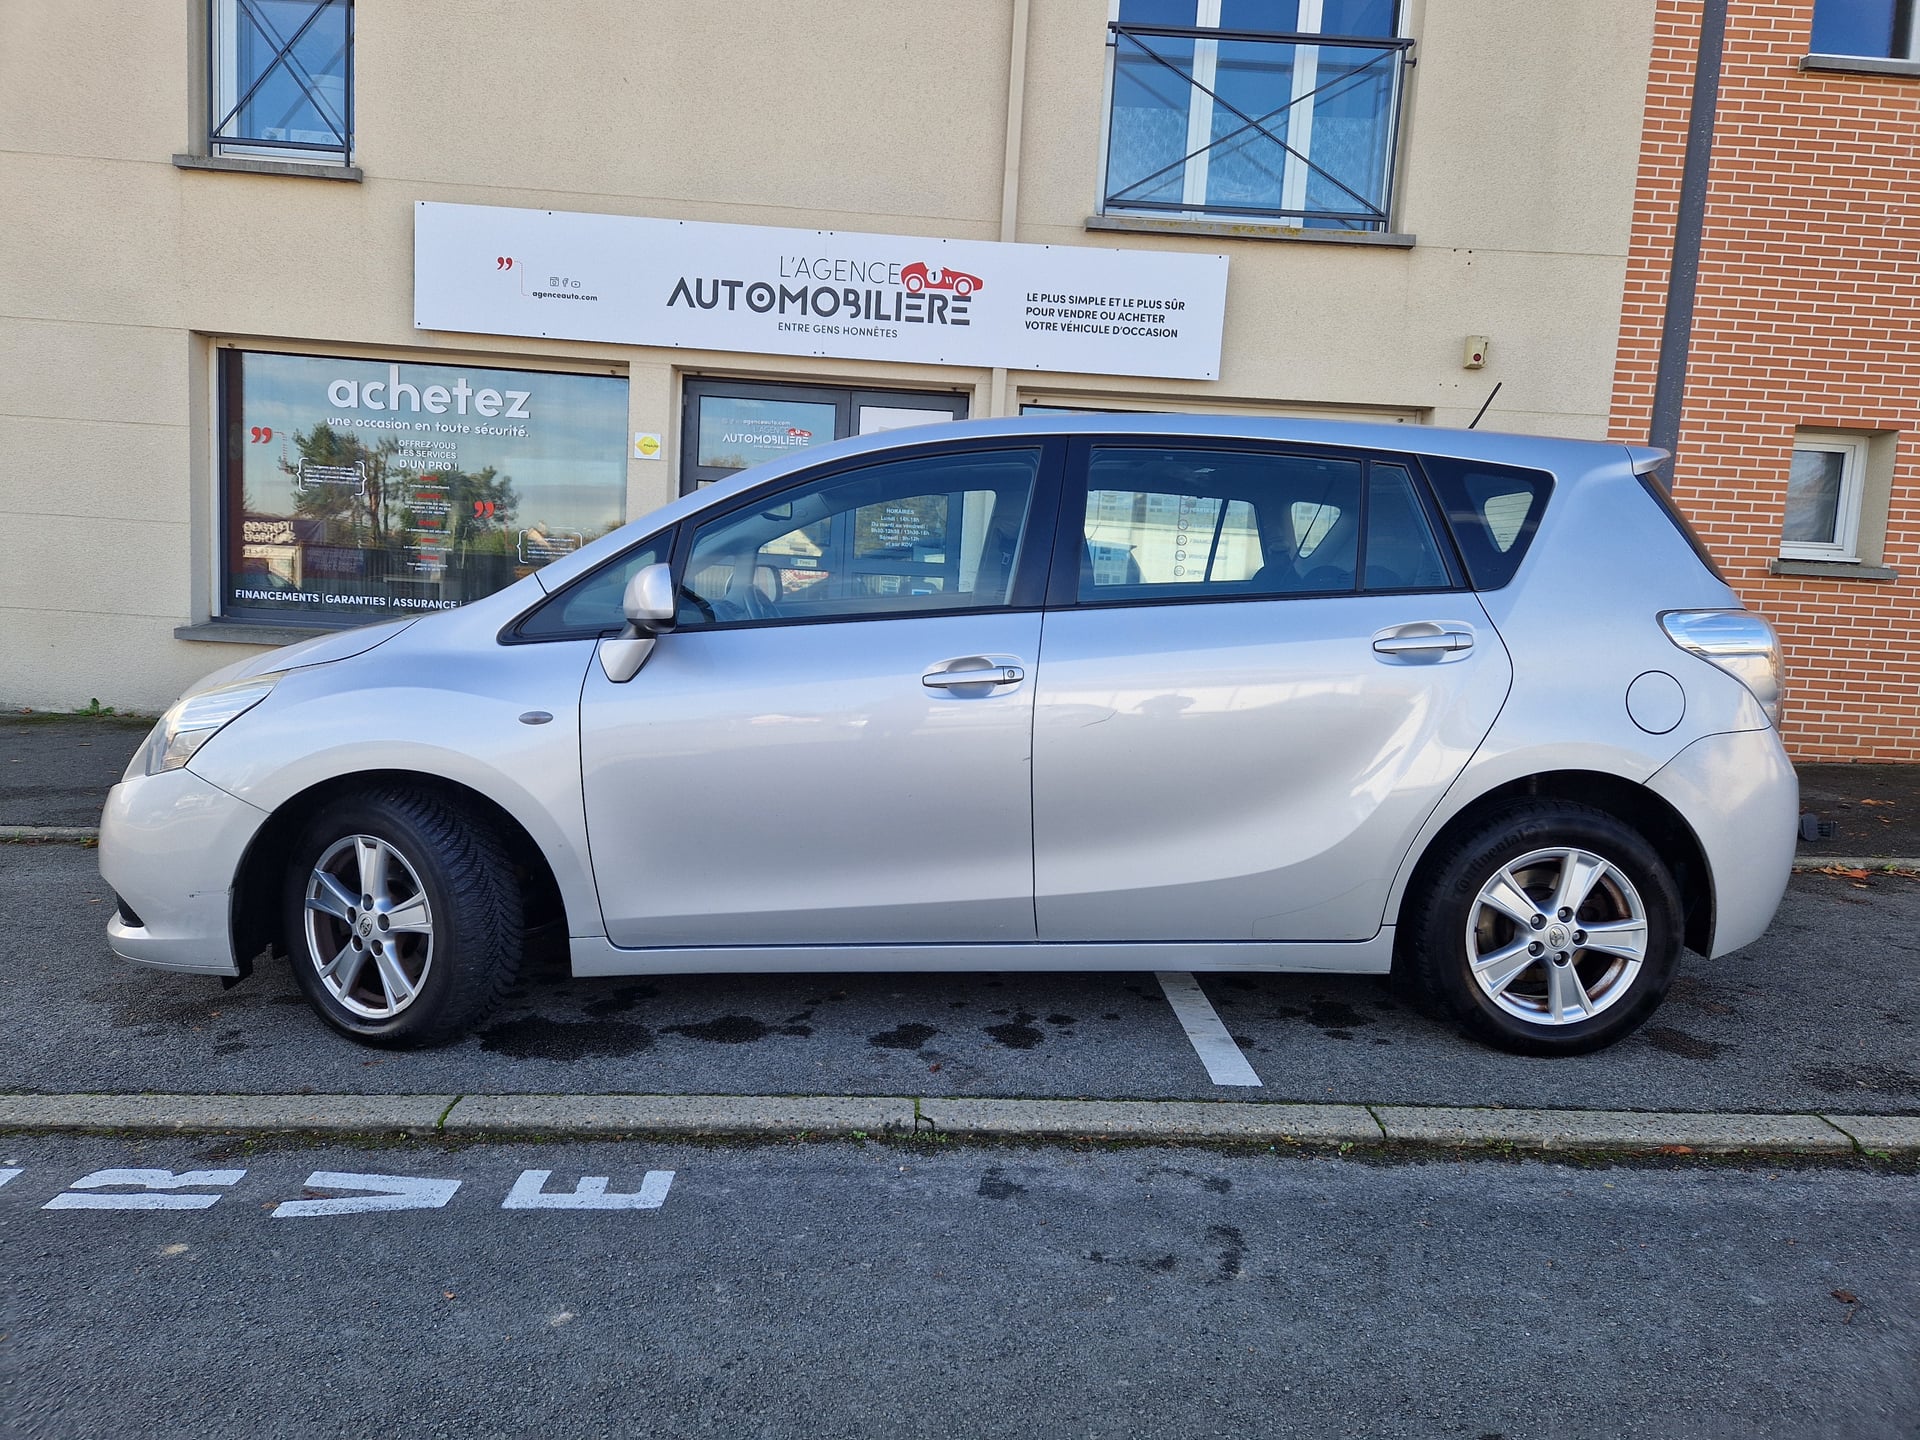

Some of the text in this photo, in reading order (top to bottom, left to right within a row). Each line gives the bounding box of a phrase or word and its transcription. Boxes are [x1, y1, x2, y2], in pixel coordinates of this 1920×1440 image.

[779, 255, 901, 285] L'AGENCE
[931, 270, 937, 281] 1
[532, 291, 598, 302] agenceauto.com
[666, 276, 972, 326] AUTOMOBILIERE
[1026, 292, 1185, 311] LE PLUS SIMPLE ET LE PLUS SÛR
[1026, 306, 1165, 323] POUR VENDRE OU ACHETER
[778, 322, 899, 338] ENTRE GENS HONNÊTES
[1025, 320, 1178, 338] VOTRE VÉHICULE D'OCCASION
[327, 364, 531, 419] achetez
[327, 417, 529, 437] une occasion en toute sécurité.
[398, 439, 457, 450] OFFREZ-VOUS
[398, 449, 457, 459] LES SERVICES
[399, 459, 425, 469] D'UN
[428, 460, 452, 471] PRO
[235, 589, 457, 609] FINANCEMENTS GARANTIES ASSURANCE
